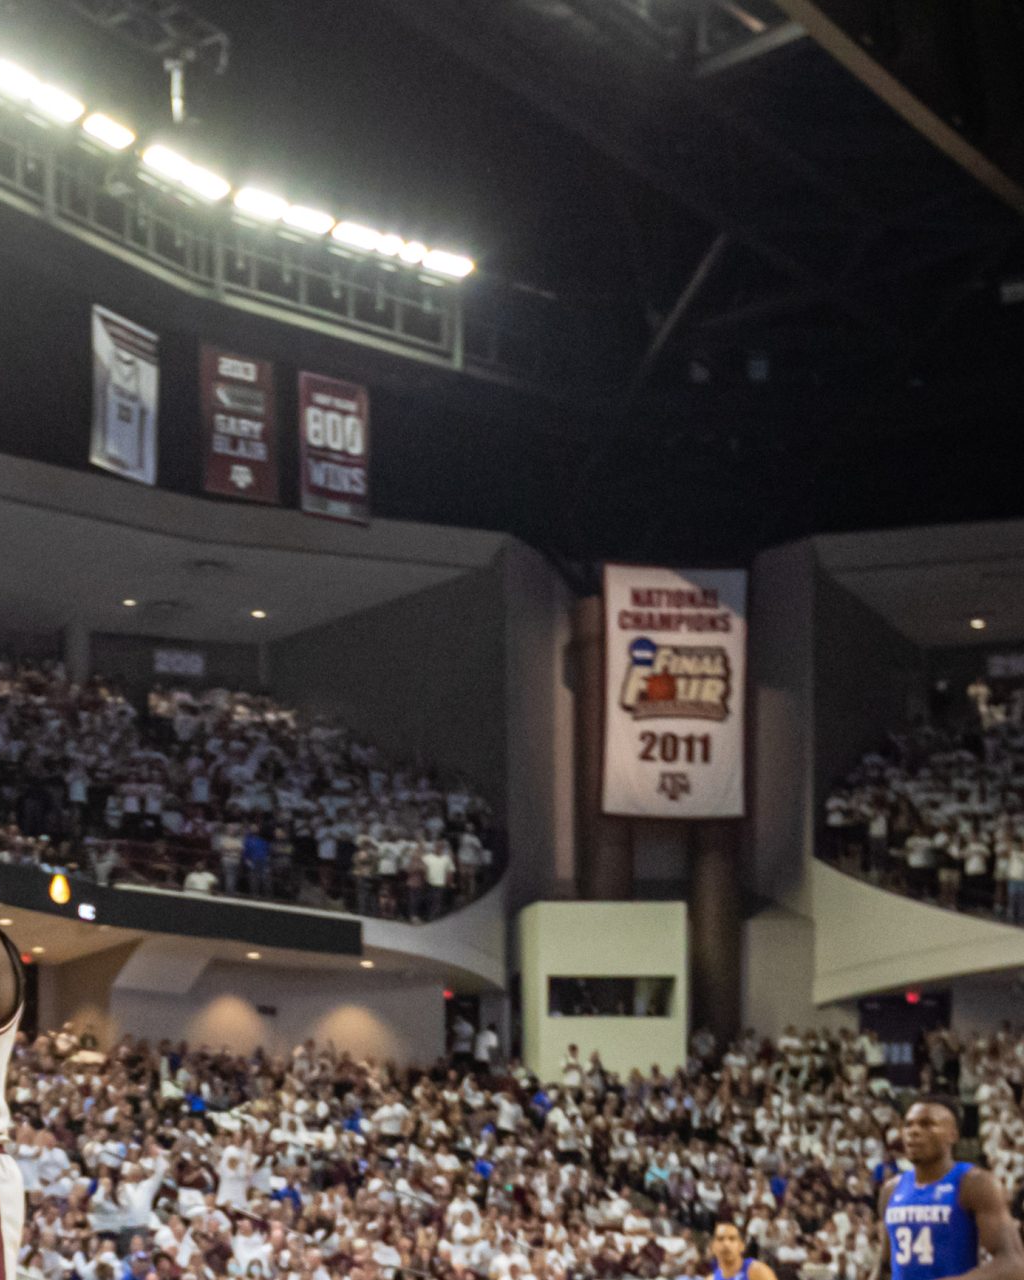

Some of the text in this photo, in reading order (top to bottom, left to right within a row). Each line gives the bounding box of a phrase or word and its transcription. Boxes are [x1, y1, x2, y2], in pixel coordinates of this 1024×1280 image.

[306, 405, 364, 457] 800
[631, 588, 719, 609] NATIONAL
[619, 610, 731, 633] CHAMPIONS
[639, 731, 711, 764] 2011
[884, 1205, 952, 1224] KENTUCKY
[895, 1226, 934, 1266] 34
